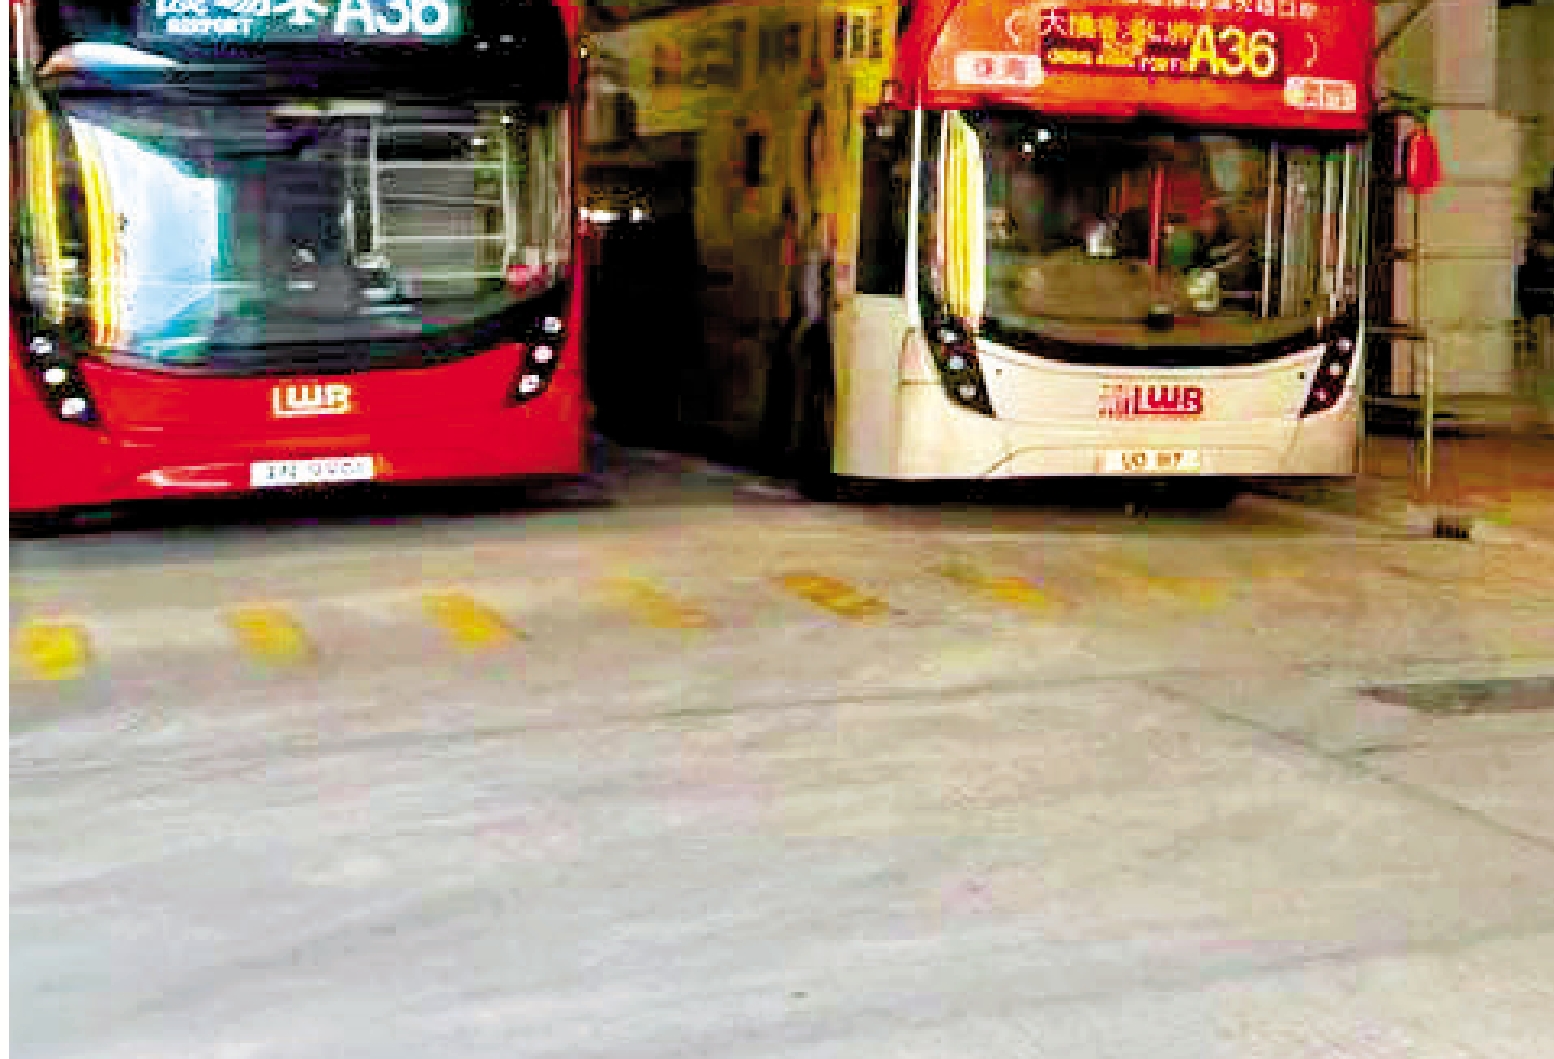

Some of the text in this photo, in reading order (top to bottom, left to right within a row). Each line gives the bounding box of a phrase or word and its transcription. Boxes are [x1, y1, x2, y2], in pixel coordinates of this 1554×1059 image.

[1189, 24, 1276, 78] A36
[272, 384, 353, 418] LWB
[1134, 385, 1204, 416] LWB
